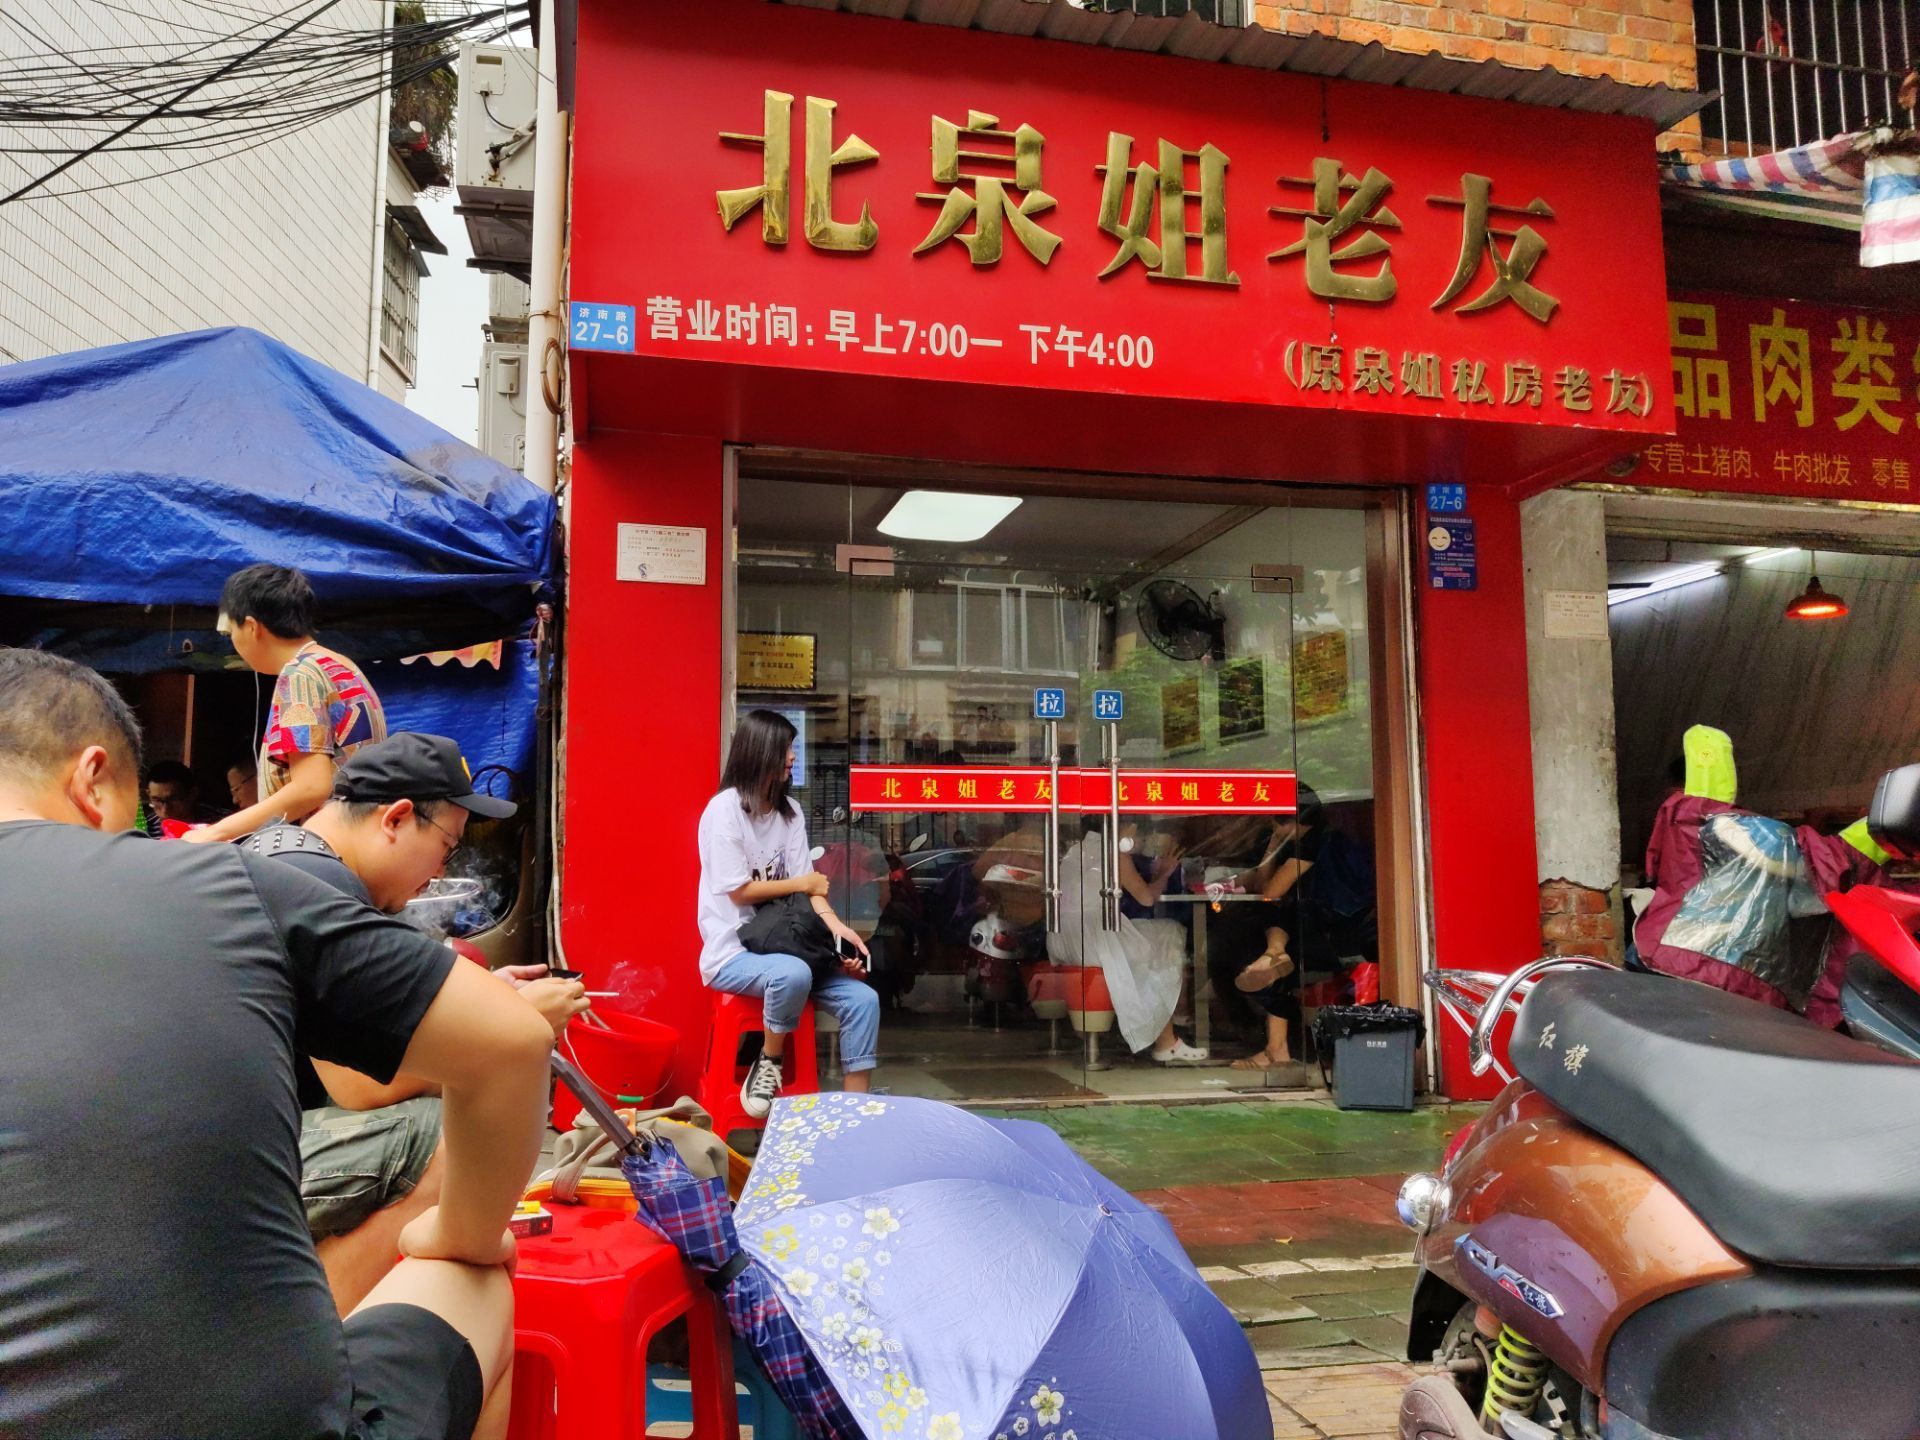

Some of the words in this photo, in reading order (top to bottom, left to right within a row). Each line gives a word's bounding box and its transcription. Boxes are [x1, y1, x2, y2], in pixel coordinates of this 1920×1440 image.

[716, 88, 1562, 326] 北泉姐老友
[575, 321, 629, 346] 27-6
[1284, 340, 1654, 418] (原泉姐私房老友)
[1668, 300, 1920, 435] 品肉类
[1430, 495, 1463, 510] 27-6
[1040, 692, 1061, 714] 拉
[1098, 694, 1120, 716] 拉
[880, 777, 1053, 800] 北泉姐老友
